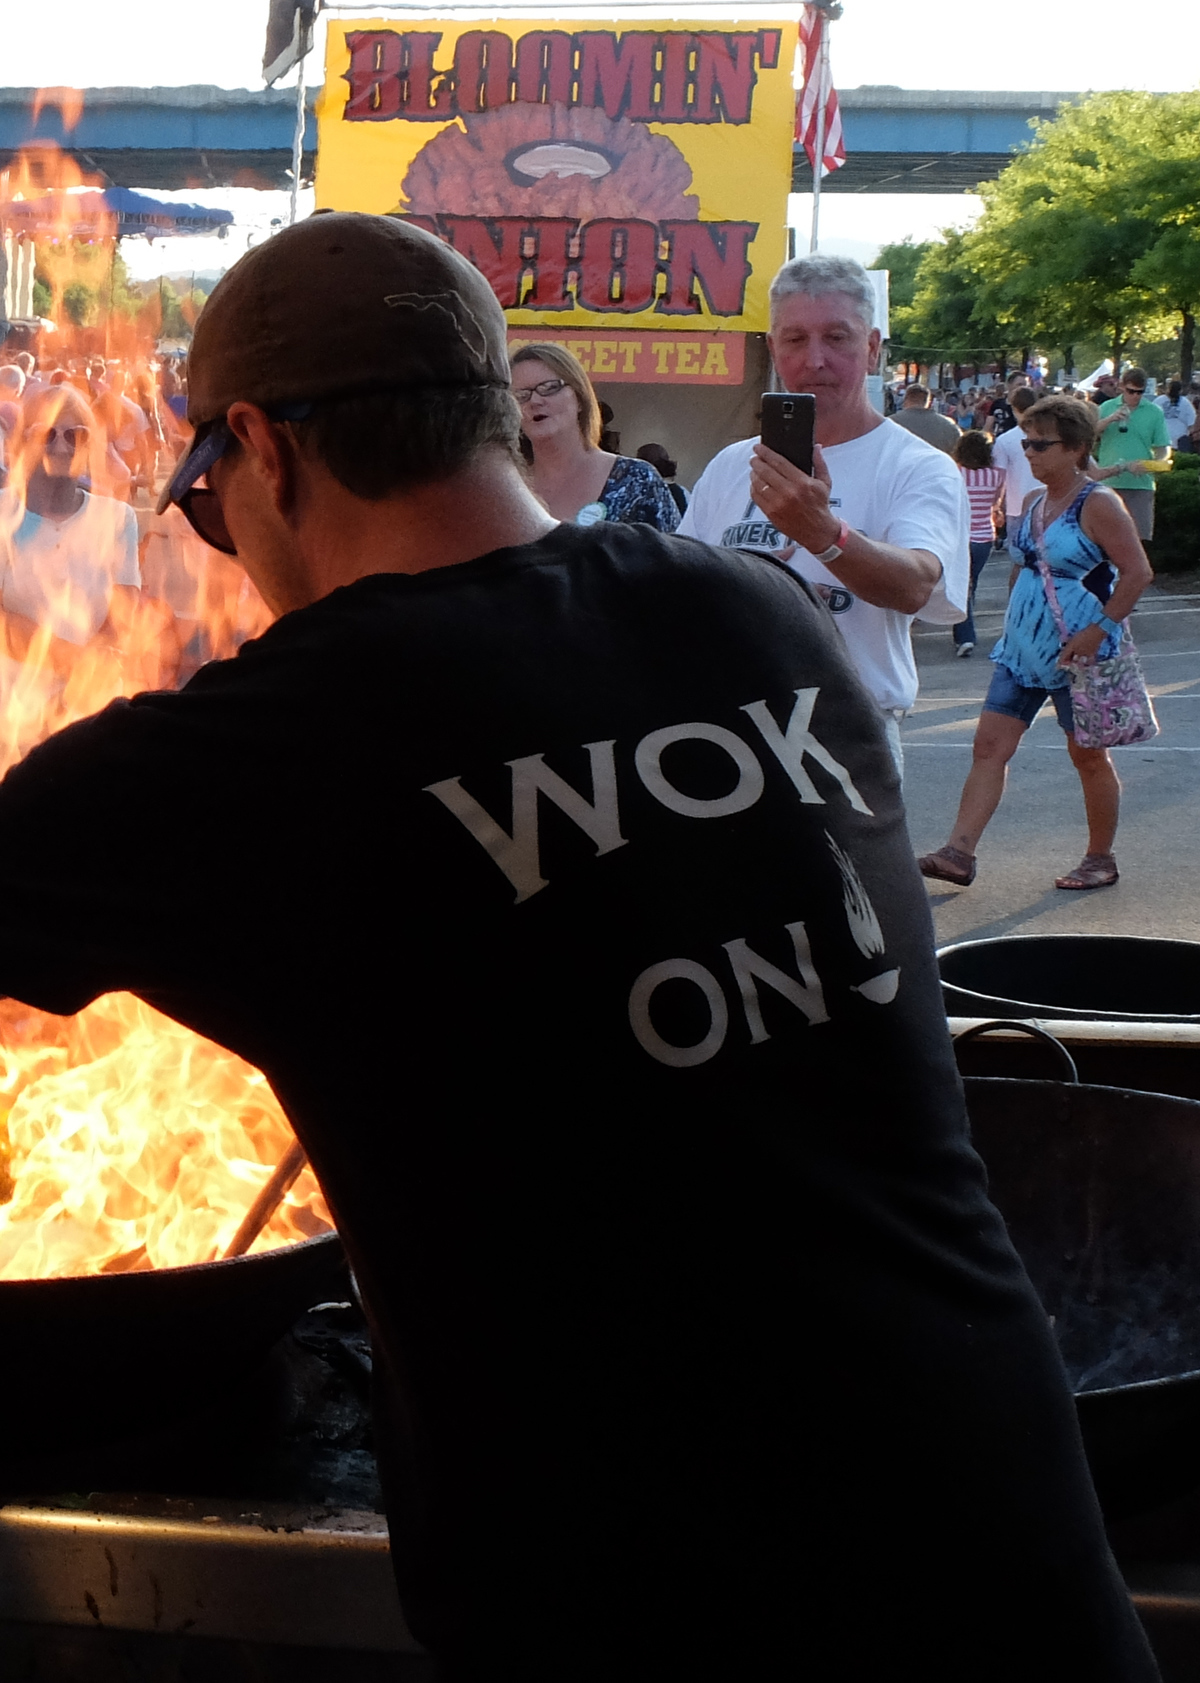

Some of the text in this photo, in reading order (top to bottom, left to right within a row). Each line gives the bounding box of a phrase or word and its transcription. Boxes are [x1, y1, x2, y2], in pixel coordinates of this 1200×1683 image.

[343, 29, 782, 124] BLOOMIN'
[386, 213, 760, 317] NION
[508, 338, 730, 376] EET TEA
[421, 686, 875, 905] WOK
